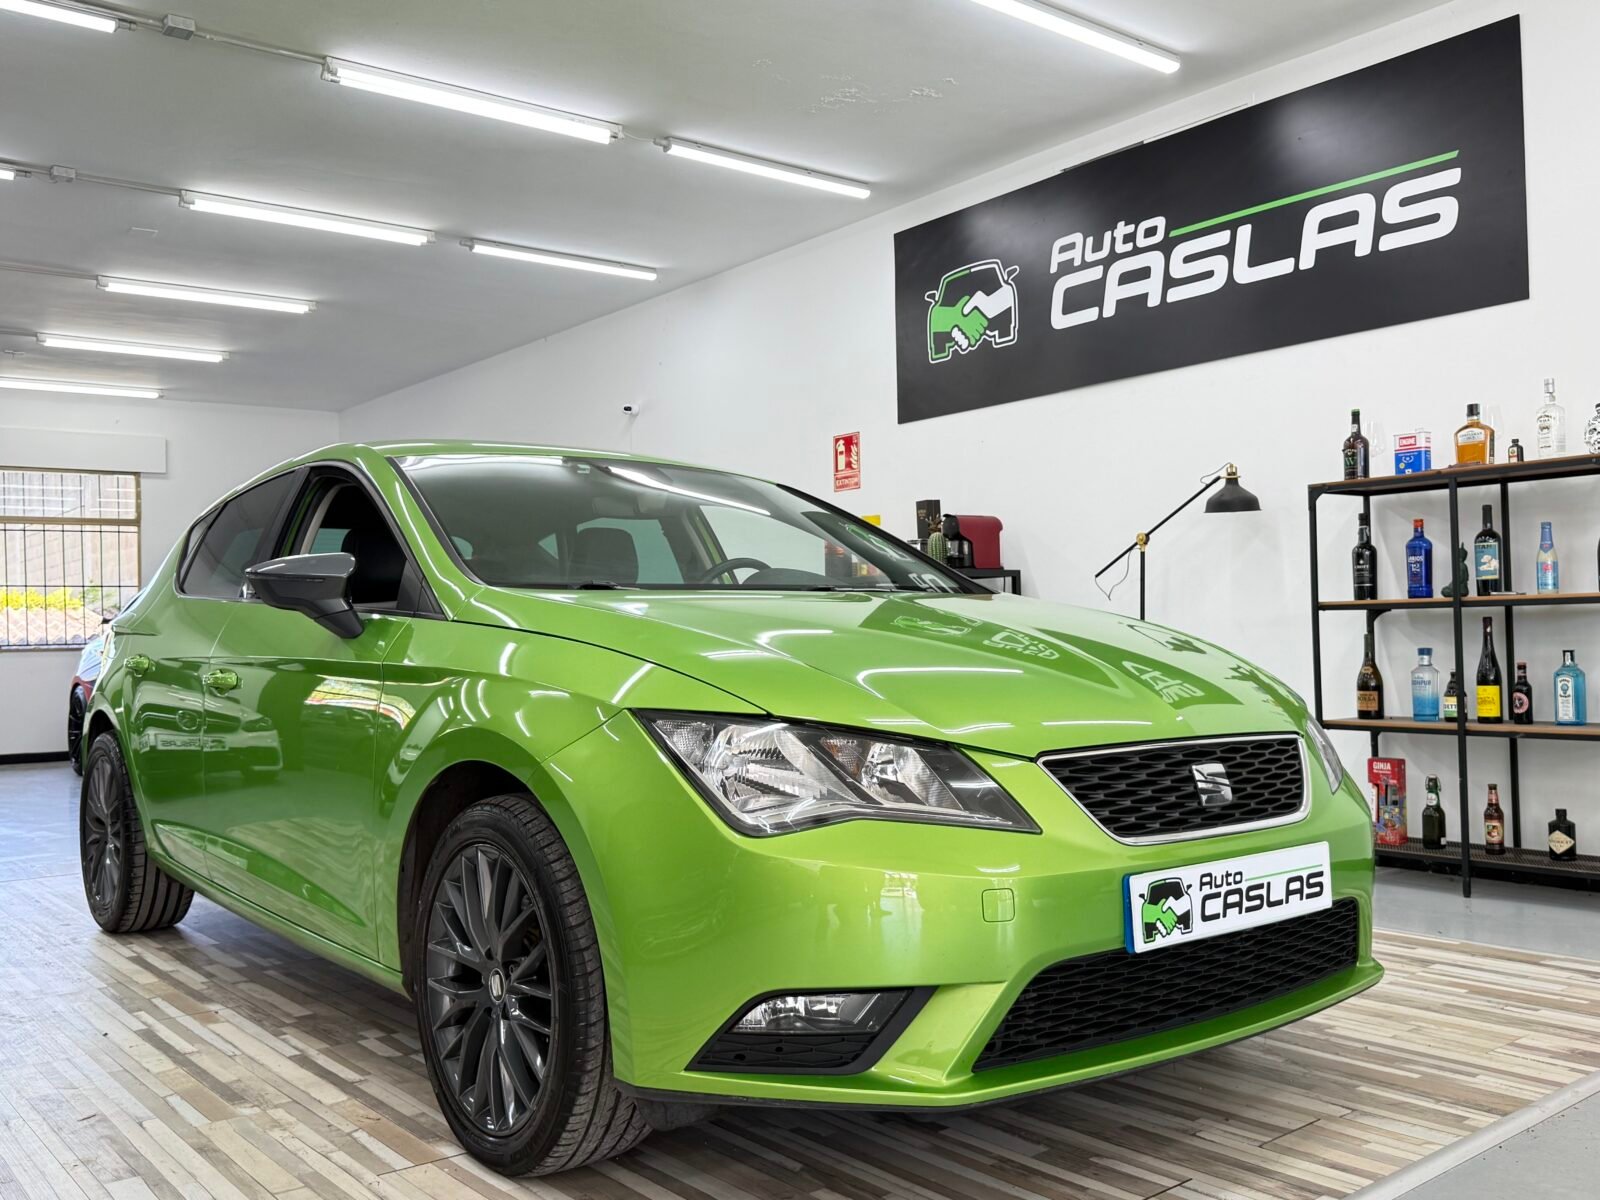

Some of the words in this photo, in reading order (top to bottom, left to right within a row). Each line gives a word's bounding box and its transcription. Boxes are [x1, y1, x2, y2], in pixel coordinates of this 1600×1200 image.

[1050, 216, 1167, 275] Auto
[1050, 167, 1462, 331] CASLAS
[1373, 761, 1391, 770] GINJA
[1200, 871, 1243, 891] Auto
[1202, 871, 1323, 921] CASLAS
